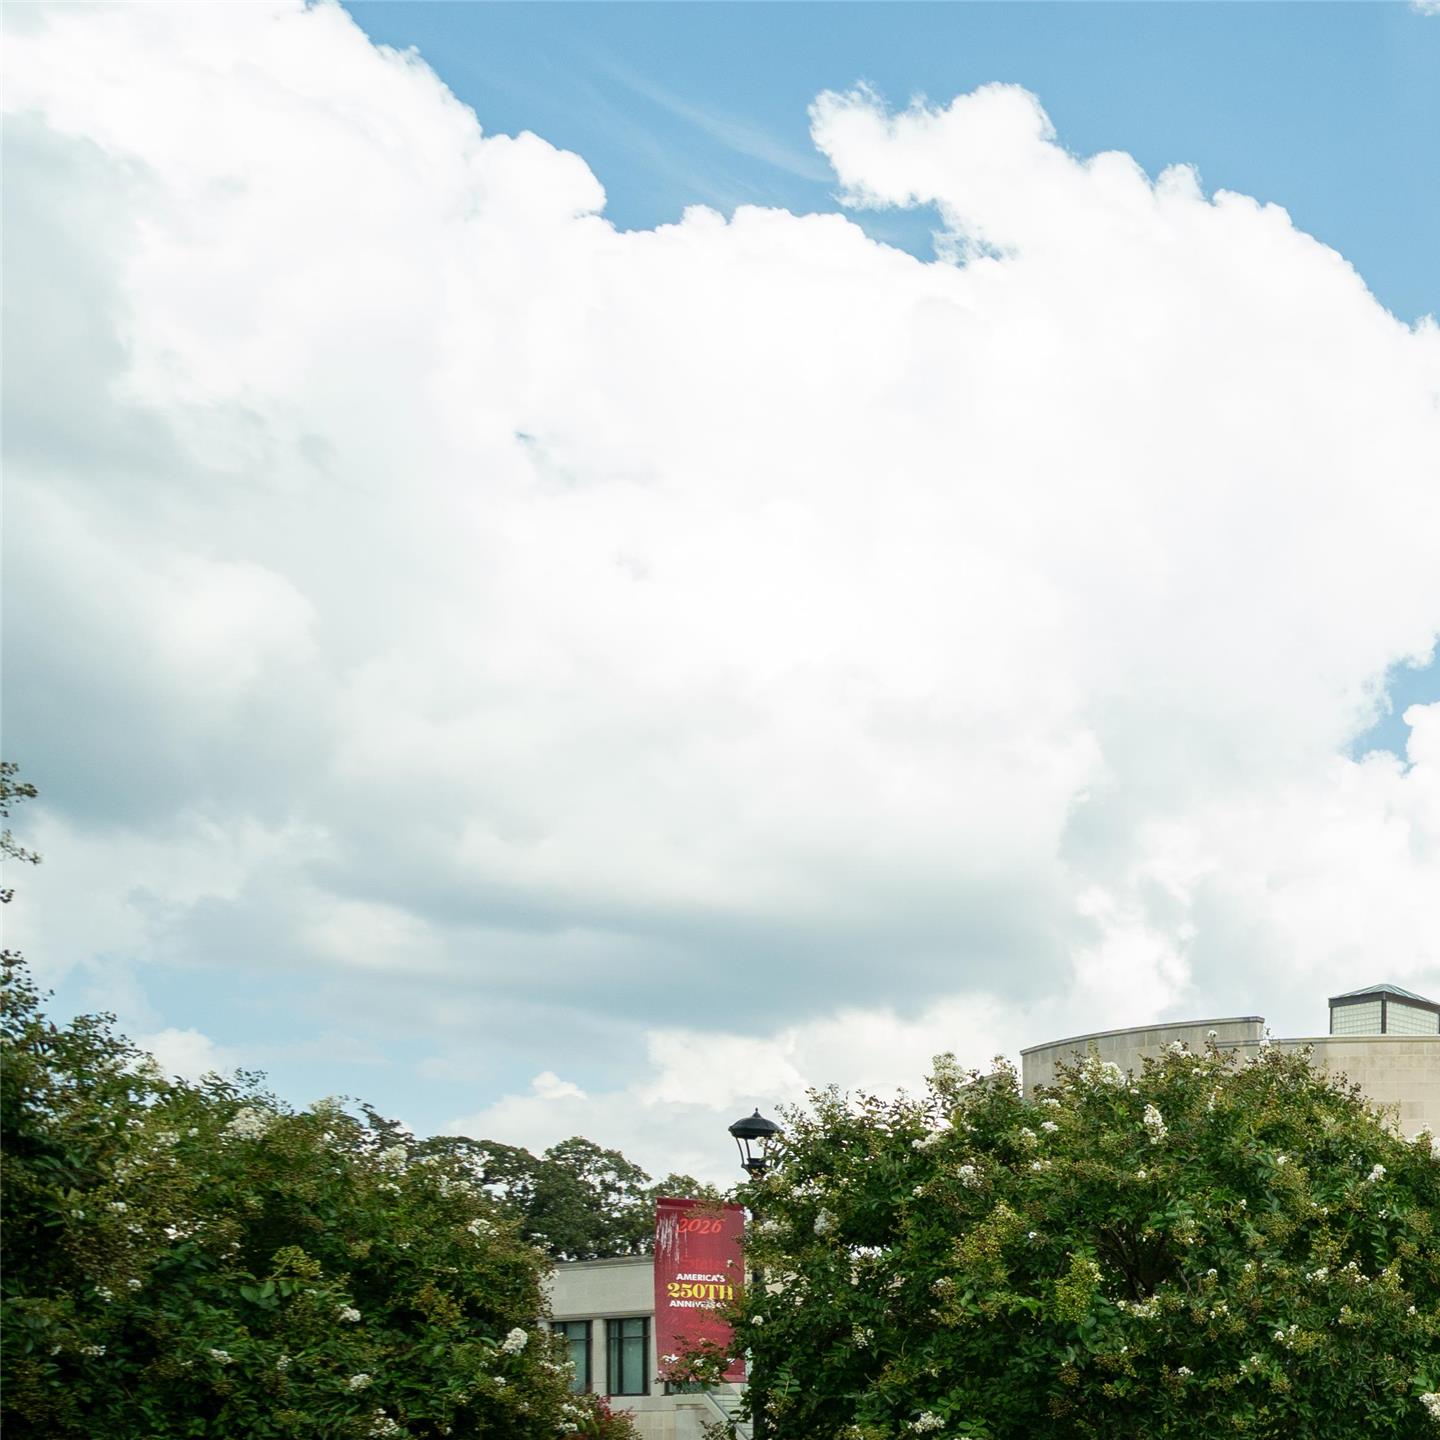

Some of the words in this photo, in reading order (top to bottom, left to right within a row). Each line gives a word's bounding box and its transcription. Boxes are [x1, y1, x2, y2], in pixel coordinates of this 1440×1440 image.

[677, 1218, 726, 1234] 2026
[676, 1273, 726, 1283] AMERICA'S
[667, 1282, 734, 1301] 250TH
